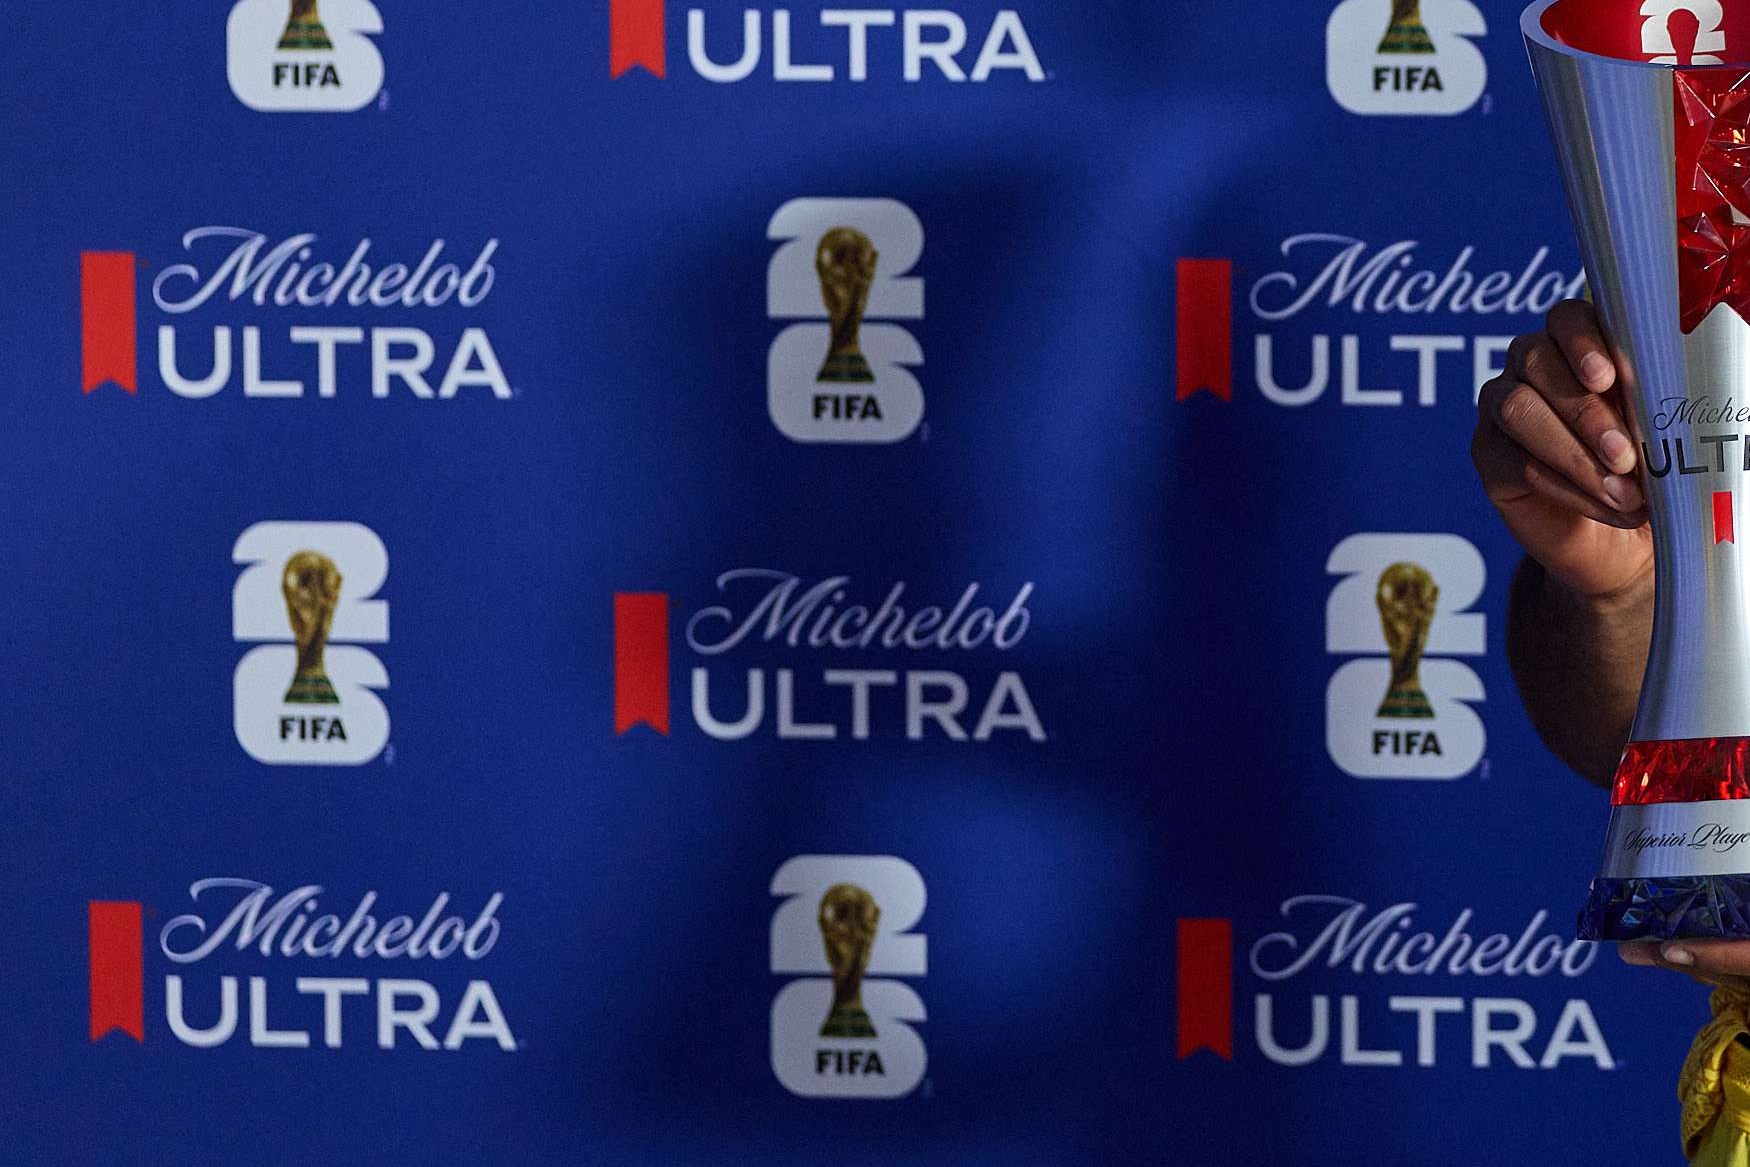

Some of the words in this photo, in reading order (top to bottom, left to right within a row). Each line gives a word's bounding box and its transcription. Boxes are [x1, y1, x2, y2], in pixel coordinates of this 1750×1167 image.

[273, 63, 341, 88] FIFA
[688, 9, 1044, 82] ULTRA
[1373, 66, 1444, 92] FIFA
[153, 227, 497, 312] Michelob
[159, 326, 512, 399] ULTRA
[1255, 334, 1516, 408] ULT
[812, 394, 883, 421] FIFA
[688, 570, 1034, 654] Michelob
[279, 716, 347, 742] FIFA
[692, 668, 1045, 740] ULTRA
[1371, 729, 1443, 757] FIFA
[1623, 827, 1687, 856] Superior
[161, 878, 502, 962] Michelob
[166, 975, 516, 1050] ULTRA
[1256, 995, 1615, 1069] ULTRA
[815, 1049, 885, 1076] FIFA
